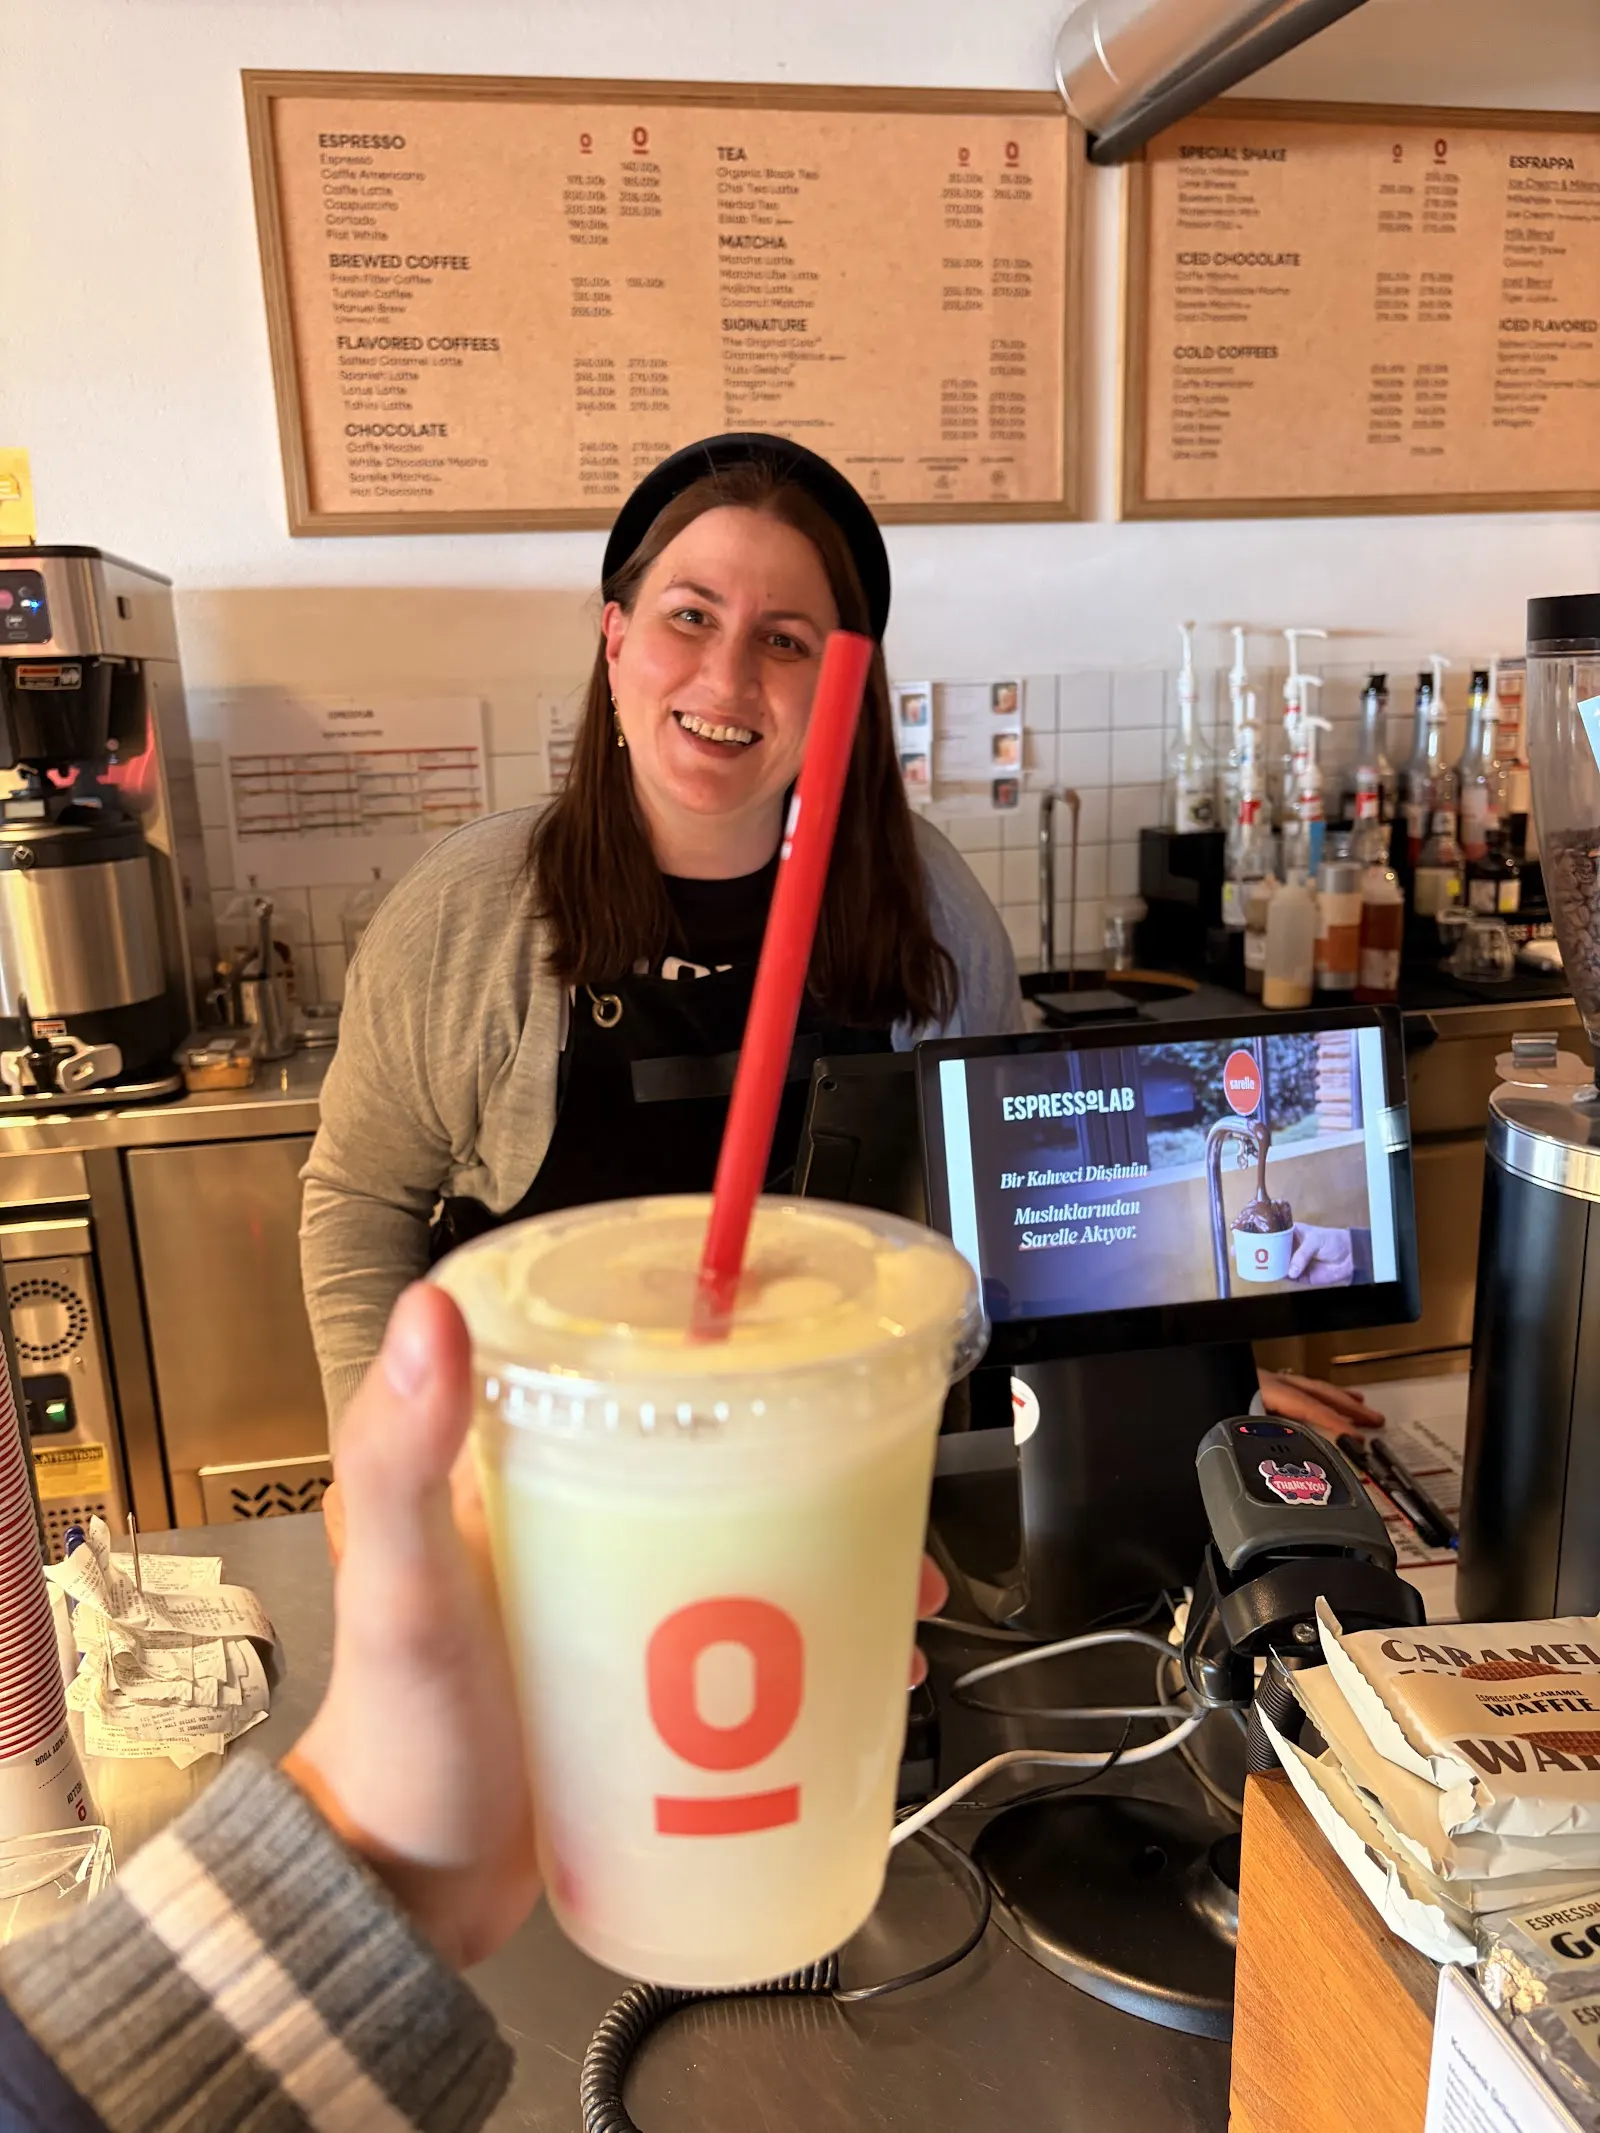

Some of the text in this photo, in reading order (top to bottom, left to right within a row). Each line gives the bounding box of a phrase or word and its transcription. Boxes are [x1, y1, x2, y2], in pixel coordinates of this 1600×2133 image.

[319, 134, 406, 149] ESPRESSO
[717, 146, 748, 161] TEA
[1179, 145, 1287, 162] SPECIAL SHAKE
[1509, 155, 1574, 170] ESFRAPPA
[719, 234, 788, 250] MATCHA
[329, 254, 471, 270] BREWED COFFEE
[1176, 252, 1300, 267] ICED CHOCOLATE
[721, 317, 808, 332] SIGNATURE
[1499, 318, 1598, 333] ICED FLAVORED
[336, 336, 500, 351] FLAVORED COFFEES
[1173, 345, 1279, 359] COLD COFFEES
[345, 423, 448, 437] CHOCOLATE
[1002, 1087, 1135, 1121] ESPRESSOLAB
[1000, 1161, 1148, 1189] Bir Kahveci Düşünün
[1014, 1199, 1140, 1226] Musluklarından
[1020, 1225, 1137, 1249] Sarelle Akıyor.
[1273, 1480, 1325, 1491] THANK YOU
[1381, 1638, 1600, 1669] CARAMEL
[1533, 1689, 1584, 1697] CARAMEL
[1482, 1698, 1600, 1717] WAFFLE
[35, 1735, 67, 1766] ENJOY YOUR
